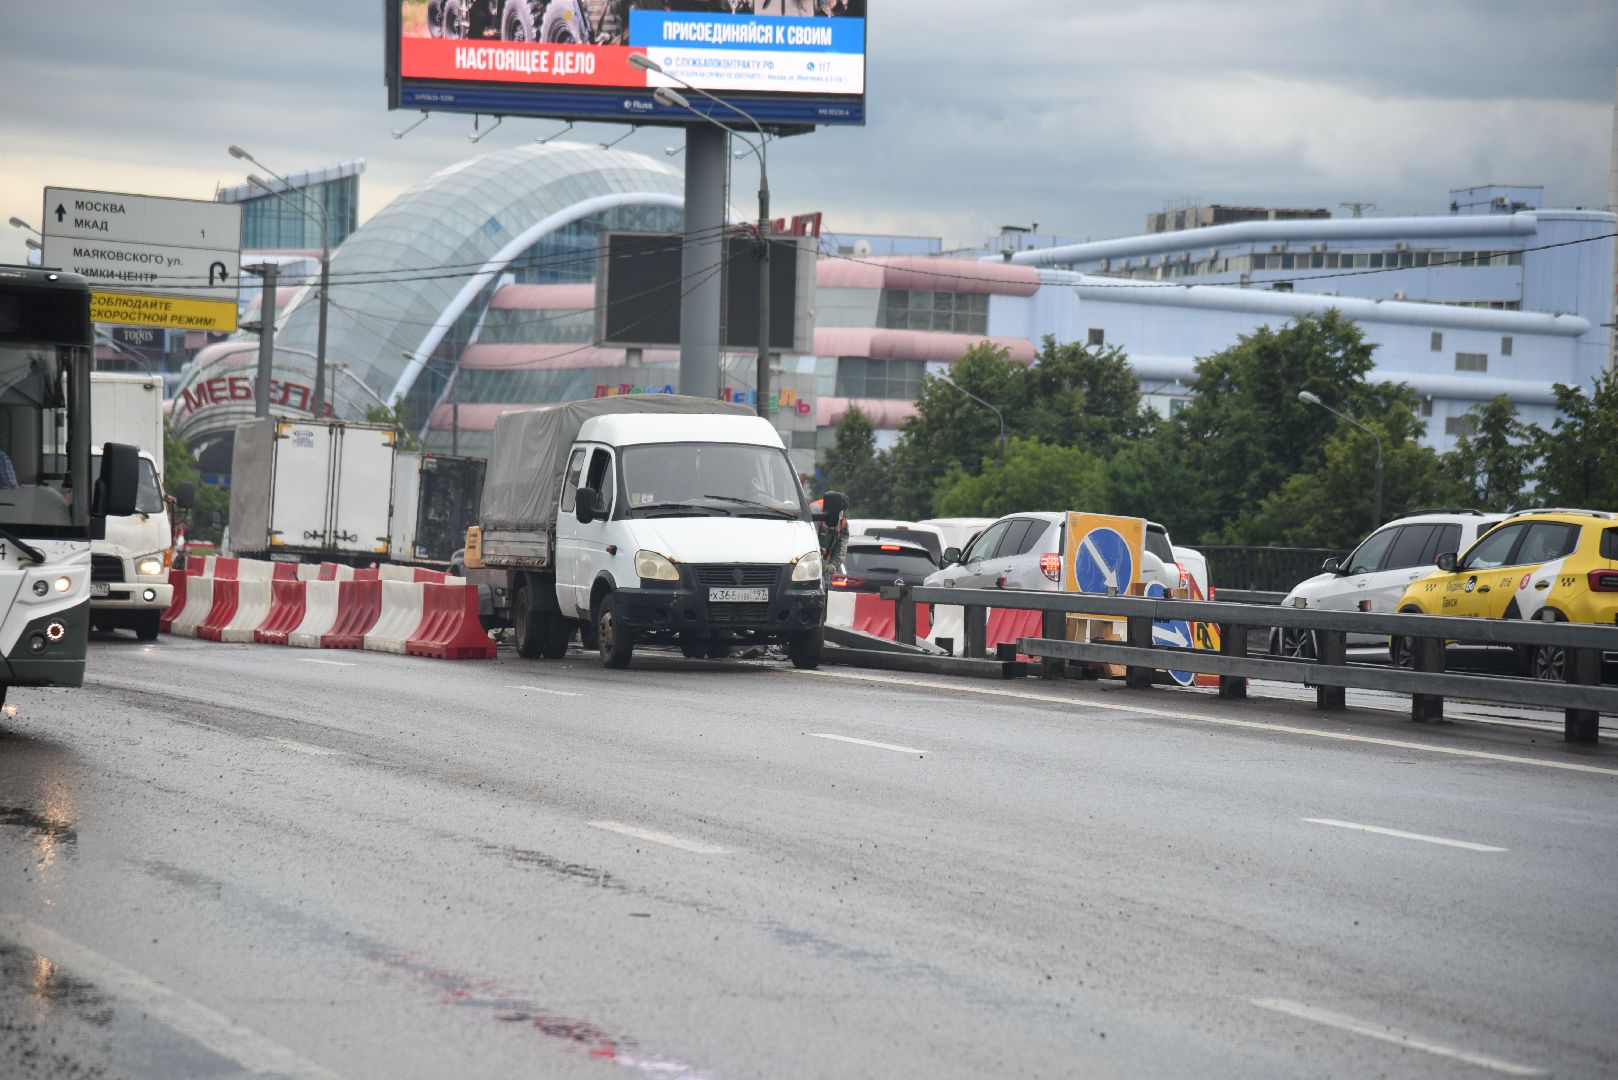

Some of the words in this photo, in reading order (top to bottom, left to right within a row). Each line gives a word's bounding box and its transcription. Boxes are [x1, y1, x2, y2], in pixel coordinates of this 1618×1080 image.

[663, 20, 772, 44] ПРИСОЕДИНЯЙСЯ
[775, 26, 784, 43] К
[788, 26, 832, 45] СВОИМ
[455, 47, 549, 74] НАСТОЯЩЕЕ
[552, 51, 596, 76] ДЕЛО
[818, 62, 831, 72] 117
[75, 201, 126, 215] МОСКВА
[74, 218, 109, 232] МКАД
[73, 248, 164, 265] МАЯКОВСКОГО
[167, 257, 184, 268] ул.
[170, 315, 216, 328] РЕЖИМ!
[1442, 596, 1458, 608] Такси
